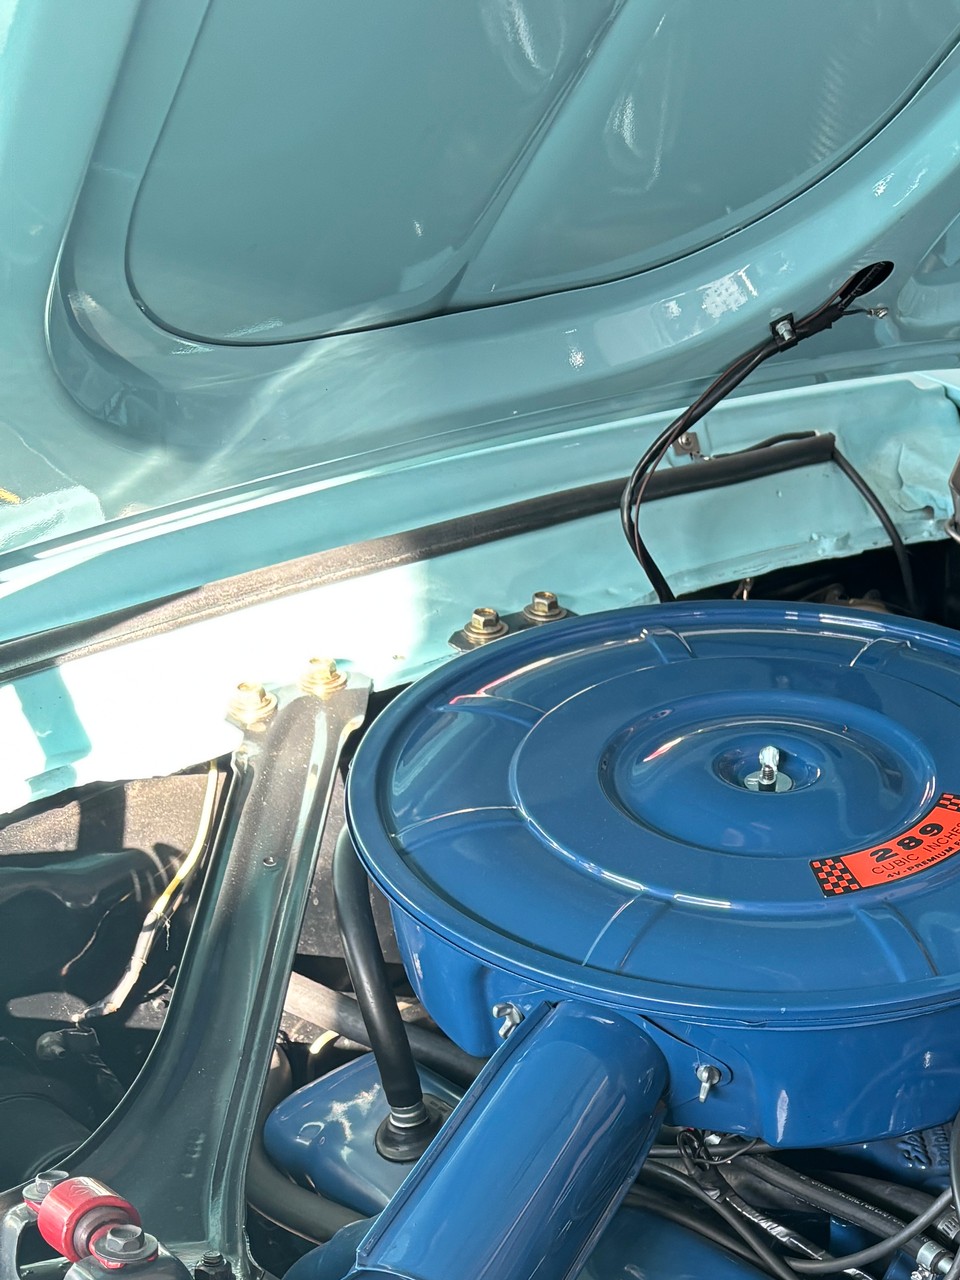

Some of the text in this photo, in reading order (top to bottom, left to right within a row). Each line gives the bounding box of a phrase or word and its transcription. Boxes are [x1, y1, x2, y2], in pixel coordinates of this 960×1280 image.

[870, 822, 943, 863] 289
[872, 853, 920, 875] CUBIC
[887, 846, 955, 879] 4V-PREMIUM
